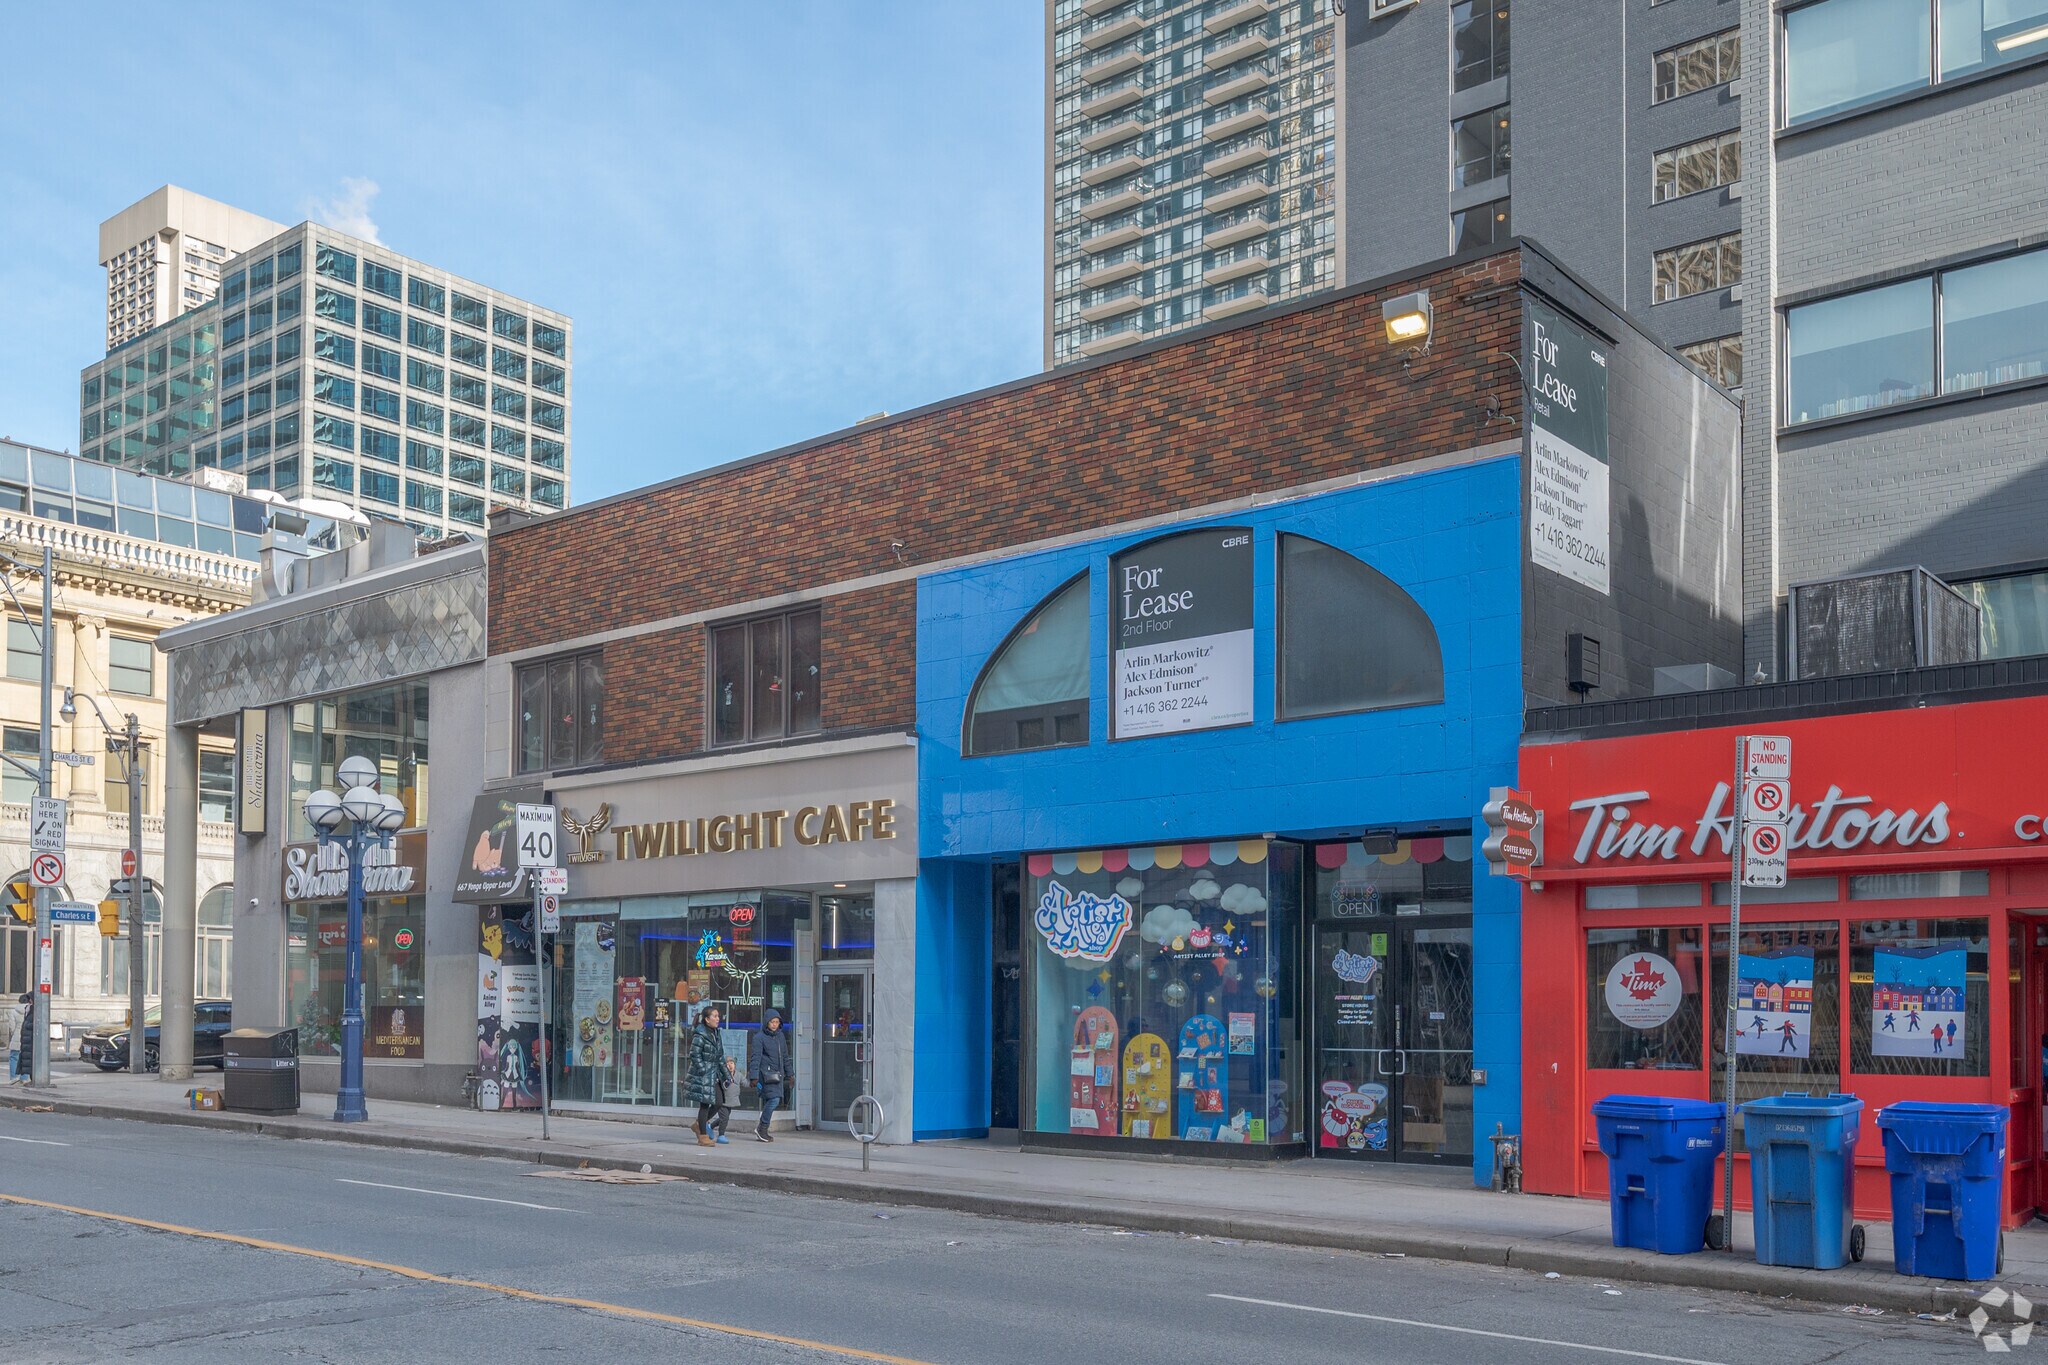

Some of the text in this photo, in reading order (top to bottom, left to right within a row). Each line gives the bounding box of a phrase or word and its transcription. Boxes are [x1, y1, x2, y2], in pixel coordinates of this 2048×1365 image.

[1533, 320, 1559, 367] For
[1591, 350, 1606, 367] CBRE
[1533, 355, 1577, 412] Lease
[1534, 397, 1550, 417] Retail
[1535, 440, 1552, 461] Arlin
[1534, 459, 1550, 478] Alex
[1534, 476, 1563, 502] Jackson
[1534, 495, 1556, 520] Teddy
[1222, 535, 1249, 548] CBRE
[1535, 522, 1545, 542] +1
[1547, 525, 1564, 550] 416
[1565, 534, 1583, 560] 362
[1584, 543, 1607, 570] 2244
[1123, 565, 1163, 593] For
[1123, 590, 1194, 620] Lease
[1123, 618, 1173, 637] 2nd Floor
[1124, 657, 1151, 669] Arlin
[1124, 672, 1147, 683] Alex
[1123, 685, 1162, 700] Jackson
[1123, 695, 1208, 716] +1 416 362 2244
[1763, 741, 1776, 751] NO
[54, 754, 78, 762] CHARLES
[79, 755, 86, 763] ST
[1751, 753, 1787, 764] STANDING
[39, 801, 58, 809] STOP
[38, 810, 58, 819] HERE
[519, 811, 552, 822] MAXIMUM
[1503, 806, 1533, 825] Tim Hortons
[1568, 781, 1951, 864] Tim Hrtons
[611, 798, 896, 861] TWILIGHT CAFE
[2014, 814, 2048, 840] C
[35, 839, 61, 847] SIGNAL
[521, 831, 553, 859] 40
[1503, 844, 1532, 856] COFFEE HOUSE
[567, 851, 600, 864] TWILIGHT
[457, 881, 513, 893] 667 Yonge Upper Level
[56, 911, 80, 919] Charles
[86, 912, 91, 920] E
[730, 908, 754, 921] OPEN
[1037, 884, 1125, 935] Artist
[1338, 903, 1373, 915] OPEN
[397, 933, 412, 944] OPEN
[1062, 916, 1116, 949] Alley
[705, 952, 728, 960] Karaoke
[1334, 950, 1374, 971] Artist
[1625, 973, 1661, 991] Tims
[728, 996, 764, 1006] TWILIGHT
[375, 1036, 420, 1045] MEDITERRANEAN
[391, 1047, 405, 1056] FOOD
